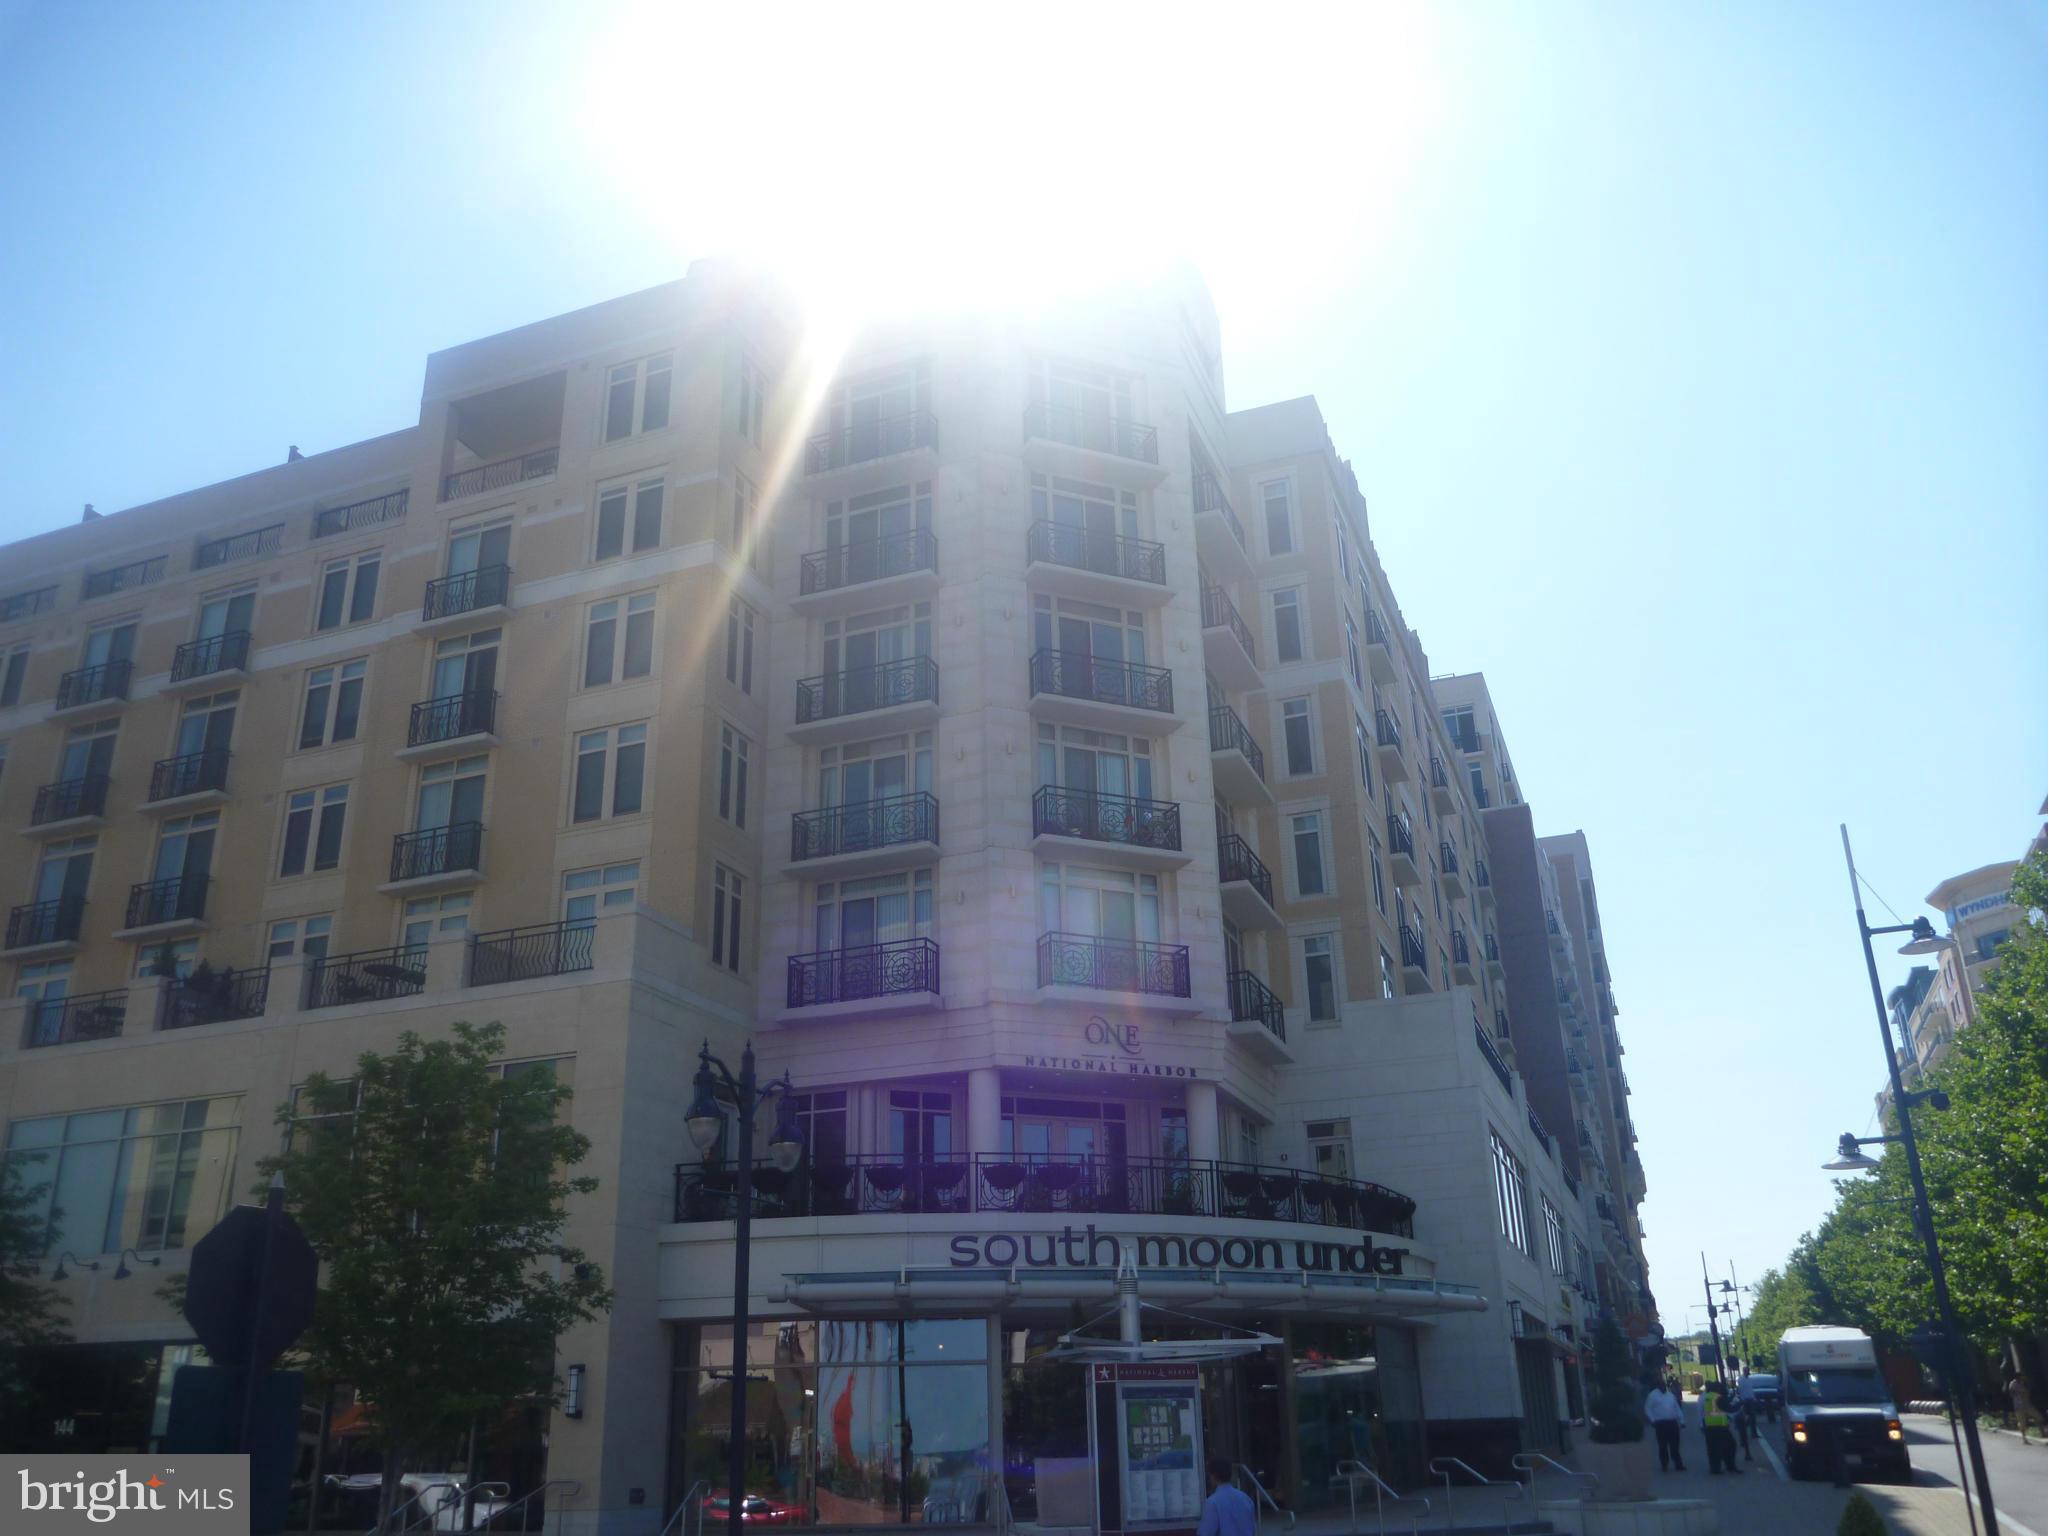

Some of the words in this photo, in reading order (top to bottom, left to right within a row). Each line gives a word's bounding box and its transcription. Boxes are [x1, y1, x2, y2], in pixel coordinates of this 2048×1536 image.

[1085, 1016, 1142, 1055] ONE
[1025, 1056, 1117, 1073] NATIONAL
[1130, 1063, 1197, 1078] HARBOR
[950, 1224, 1120, 1266] south
[1137, 1235, 1284, 1268] moon
[1296, 1235, 1409, 1275] under
